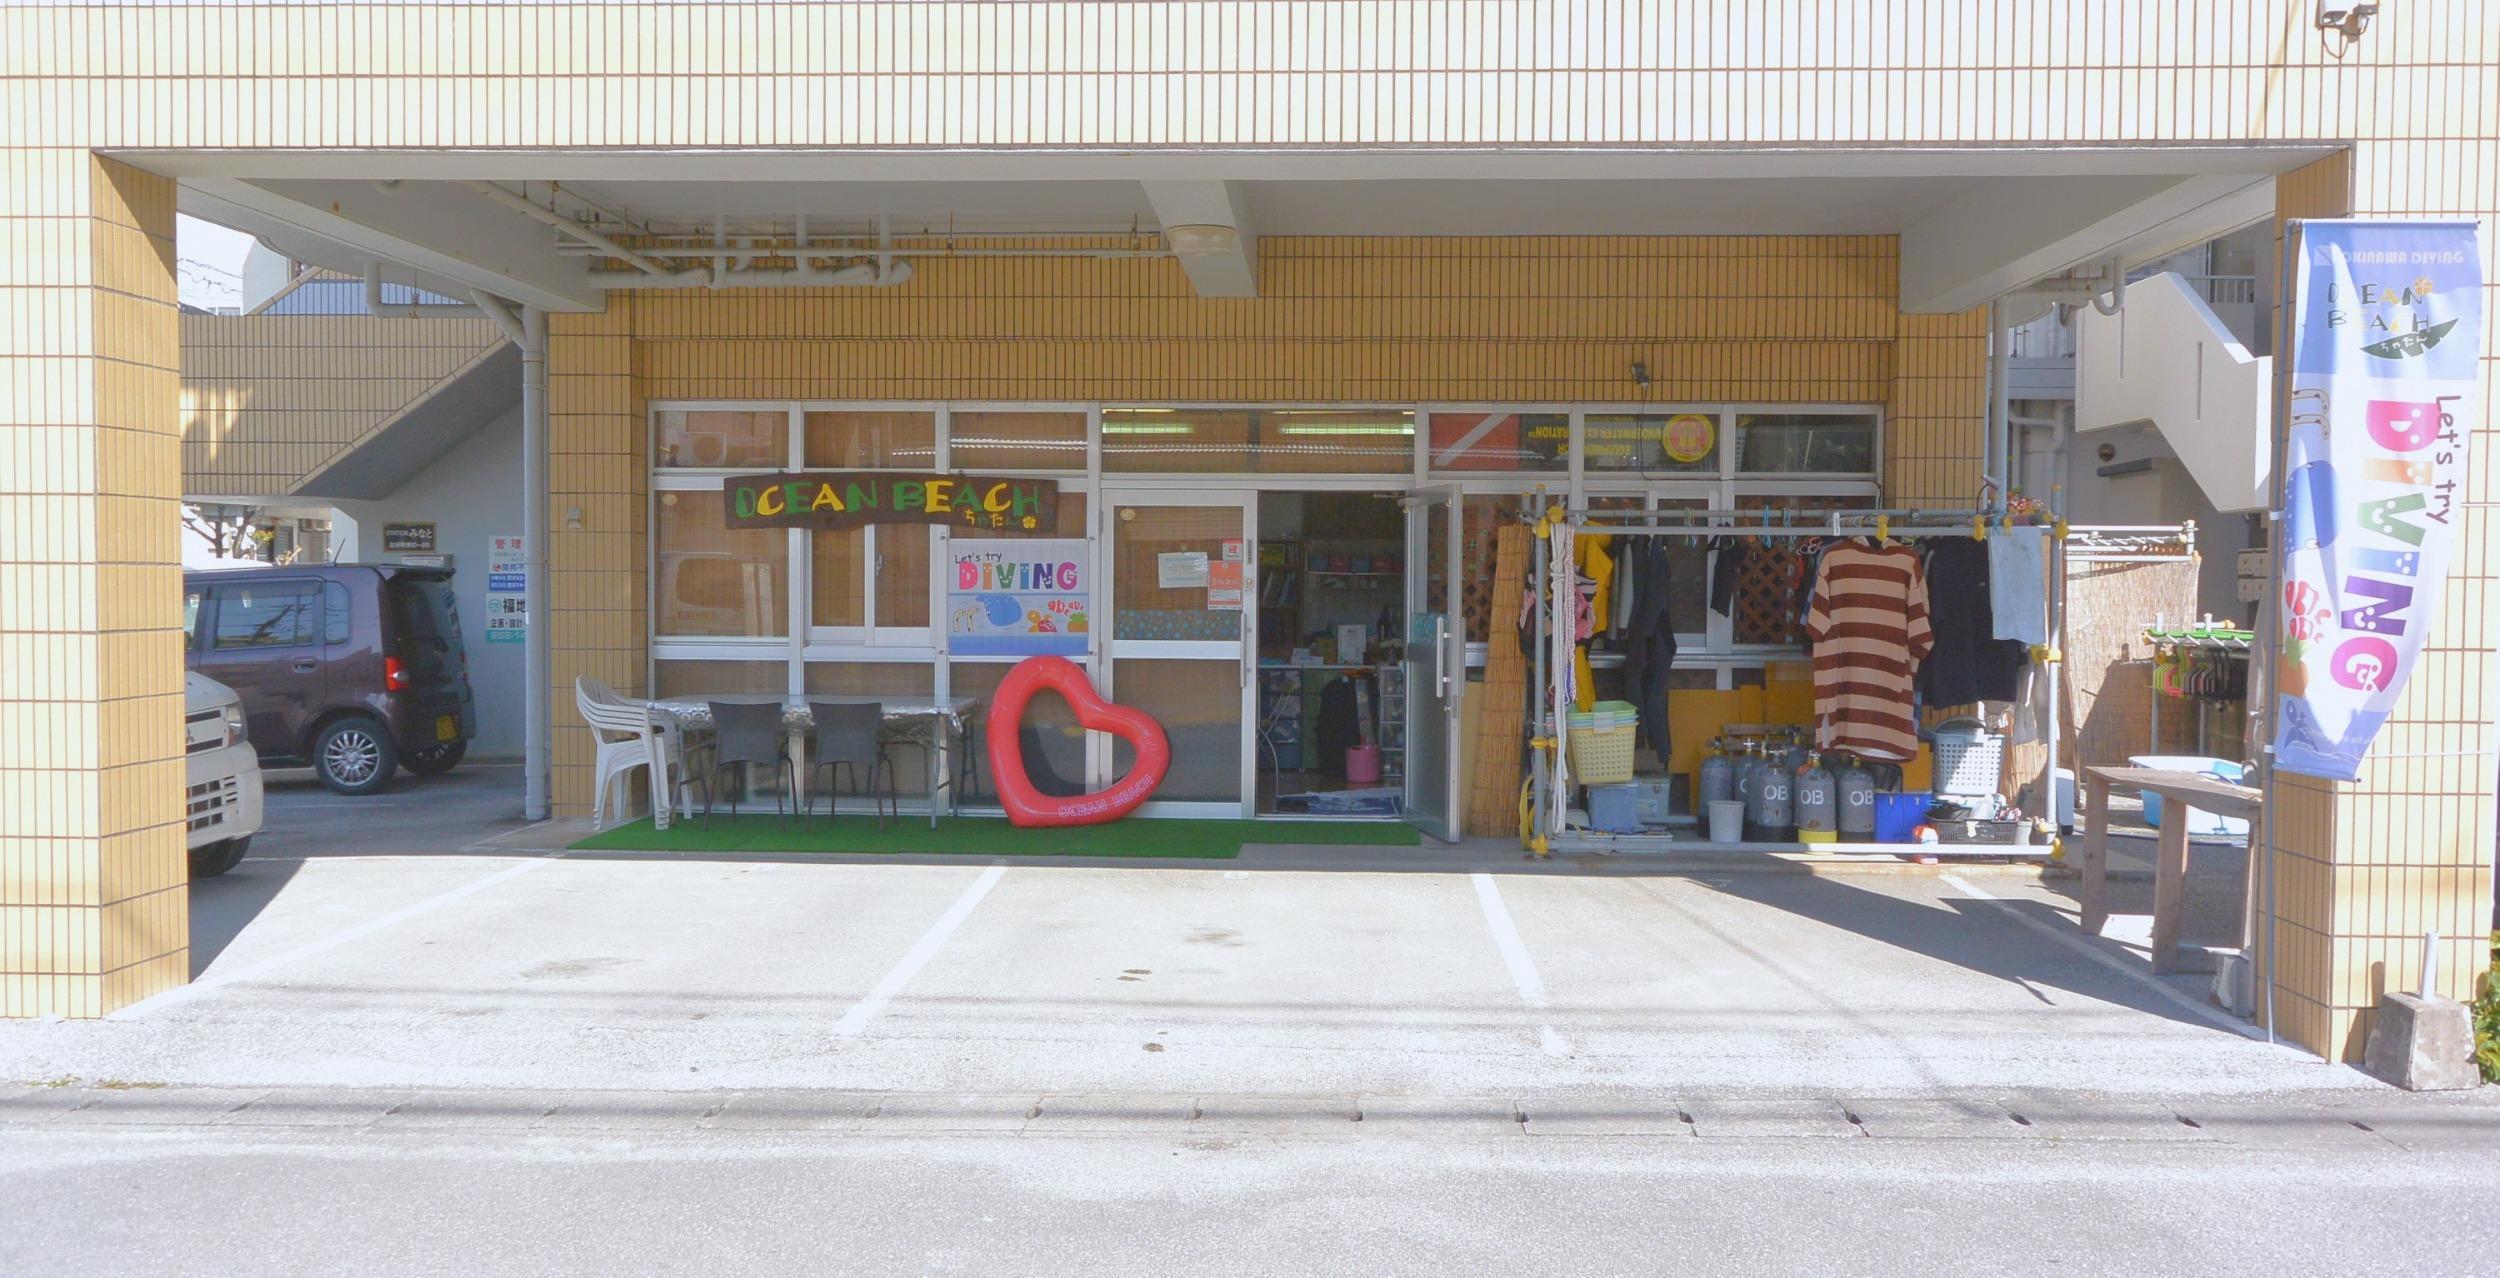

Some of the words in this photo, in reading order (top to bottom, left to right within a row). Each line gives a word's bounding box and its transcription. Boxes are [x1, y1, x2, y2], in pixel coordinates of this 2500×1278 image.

[2411, 251, 2464, 264] DIVING
[2436, 395, 2462, 465] Let's
[735, 480, 878, 519] OCEAN
[892, 480, 1041, 517] BEACH
[2426, 479, 2457, 524] try
[2330, 399, 2442, 693] DIVING
[954, 552, 981, 564] Let's
[985, 552, 1002, 563] try
[958, 562, 1078, 591] DIVING
[1764, 785, 1788, 801] OB
[1800, 789, 1824, 805] OB
[1850, 790, 1873, 806] OB
